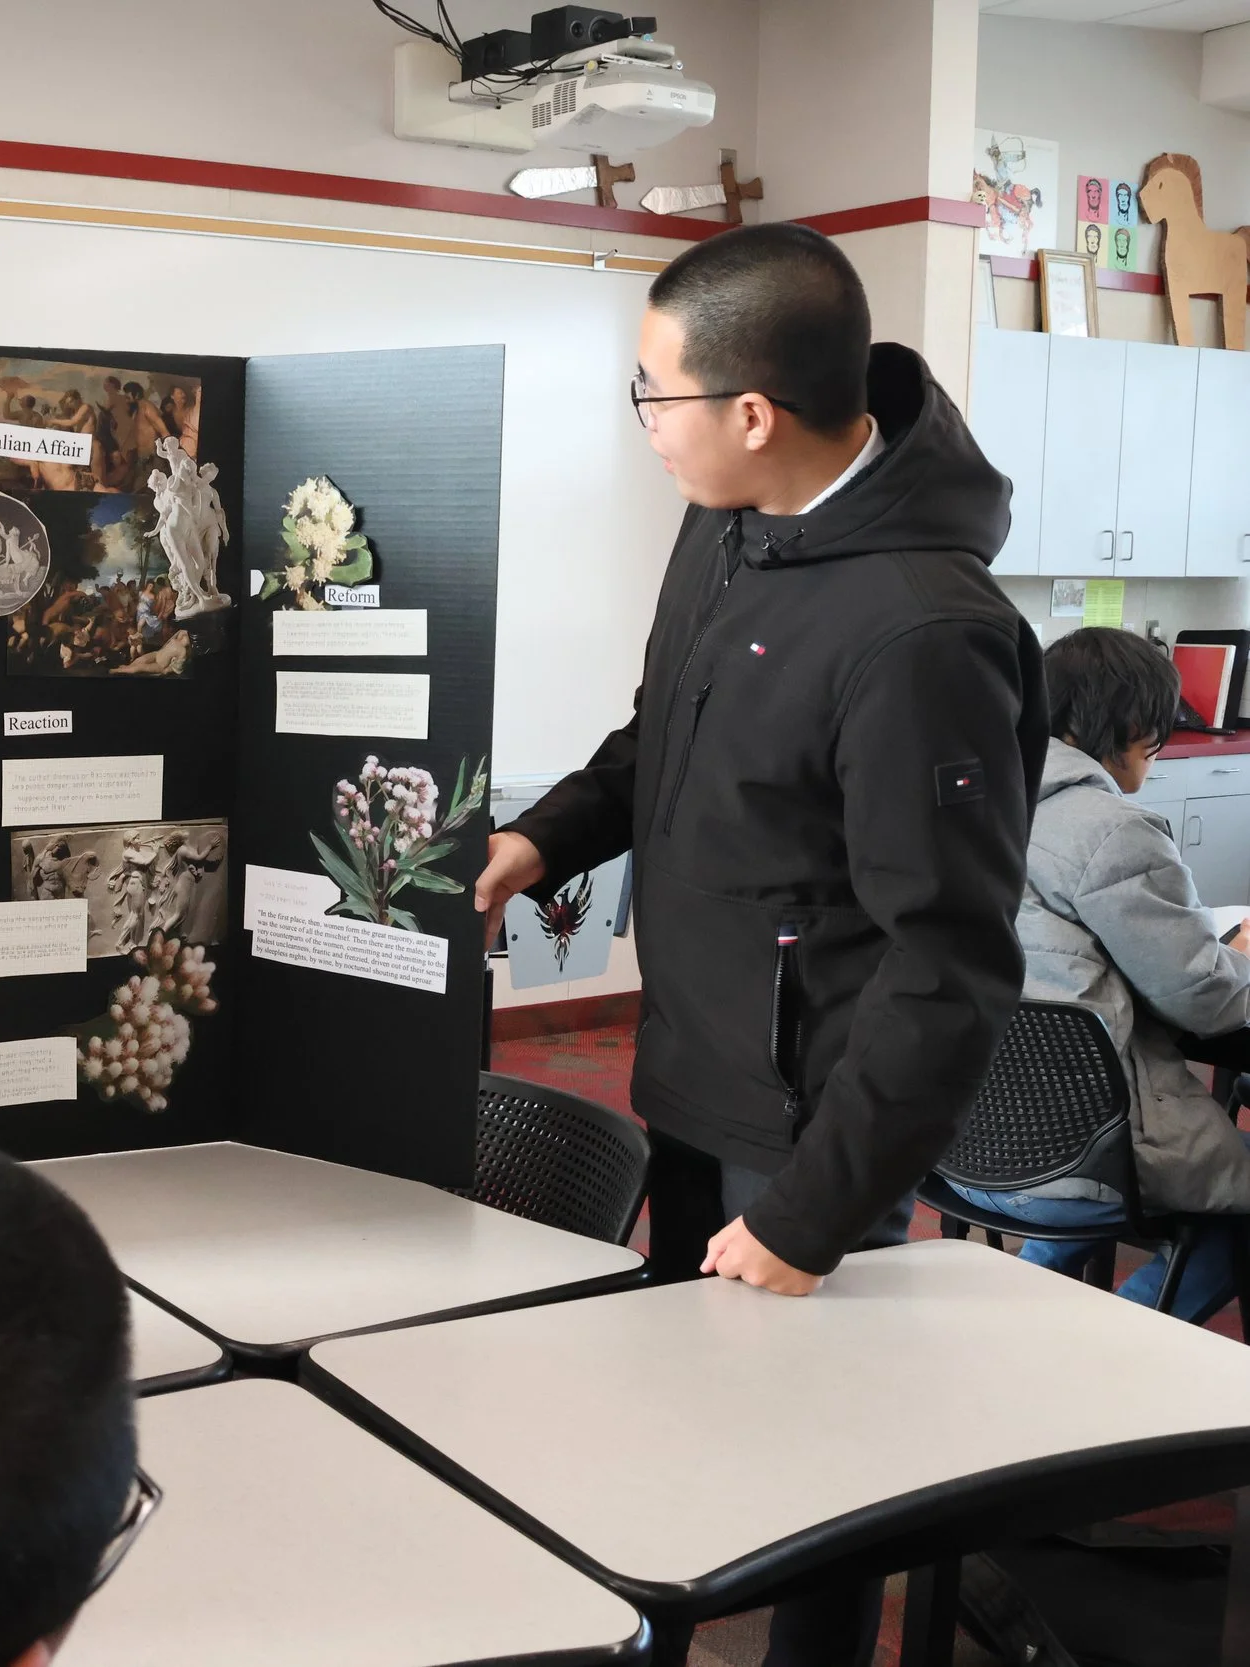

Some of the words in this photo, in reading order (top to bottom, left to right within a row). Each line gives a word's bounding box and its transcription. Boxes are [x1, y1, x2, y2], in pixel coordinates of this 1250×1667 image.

[670, 91, 687, 100] EPSON
[36, 439, 84, 458] Affair
[328, 588, 375, 603] Reform
[8, 714, 68, 730] Reaction
[257, 928, 269, 936] very
[313, 938, 322, 946] the
[346, 945, 380, 958] committing
[394, 954, 426, 966] submitting
[435, 960, 445, 968] the
[270, 920, 278, 928] the
[280, 924, 298, 932] source
[314, 929, 323, 937] the
[353, 936, 368, 944] Then
[369, 939, 383, 948] there
[396, 943, 404, 952] the
[427, 949, 436, 958] the
[324, 922, 345, 931] women
[346, 926, 360, 934] form
[361, 928, 370, 936] the
[372, 931, 387, 939] great
[416, 938, 428, 946] and
[428, 940, 440, 948] this
[256, 945, 264, 953] by
[265, 947, 288, 958] sleepless
[310, 955, 316, 964] by
[335, 960, 342, 968] by
[344, 964, 372, 974] nocturnal
[373, 967, 398, 979] shouting
[400, 973, 410, 981] and
[257, 936, 275, 946] foulest
[312, 947, 330, 956] frantic
[371, 958, 390, 968] driven
[410, 966, 424, 974] their
[426, 970, 445, 978] senses
